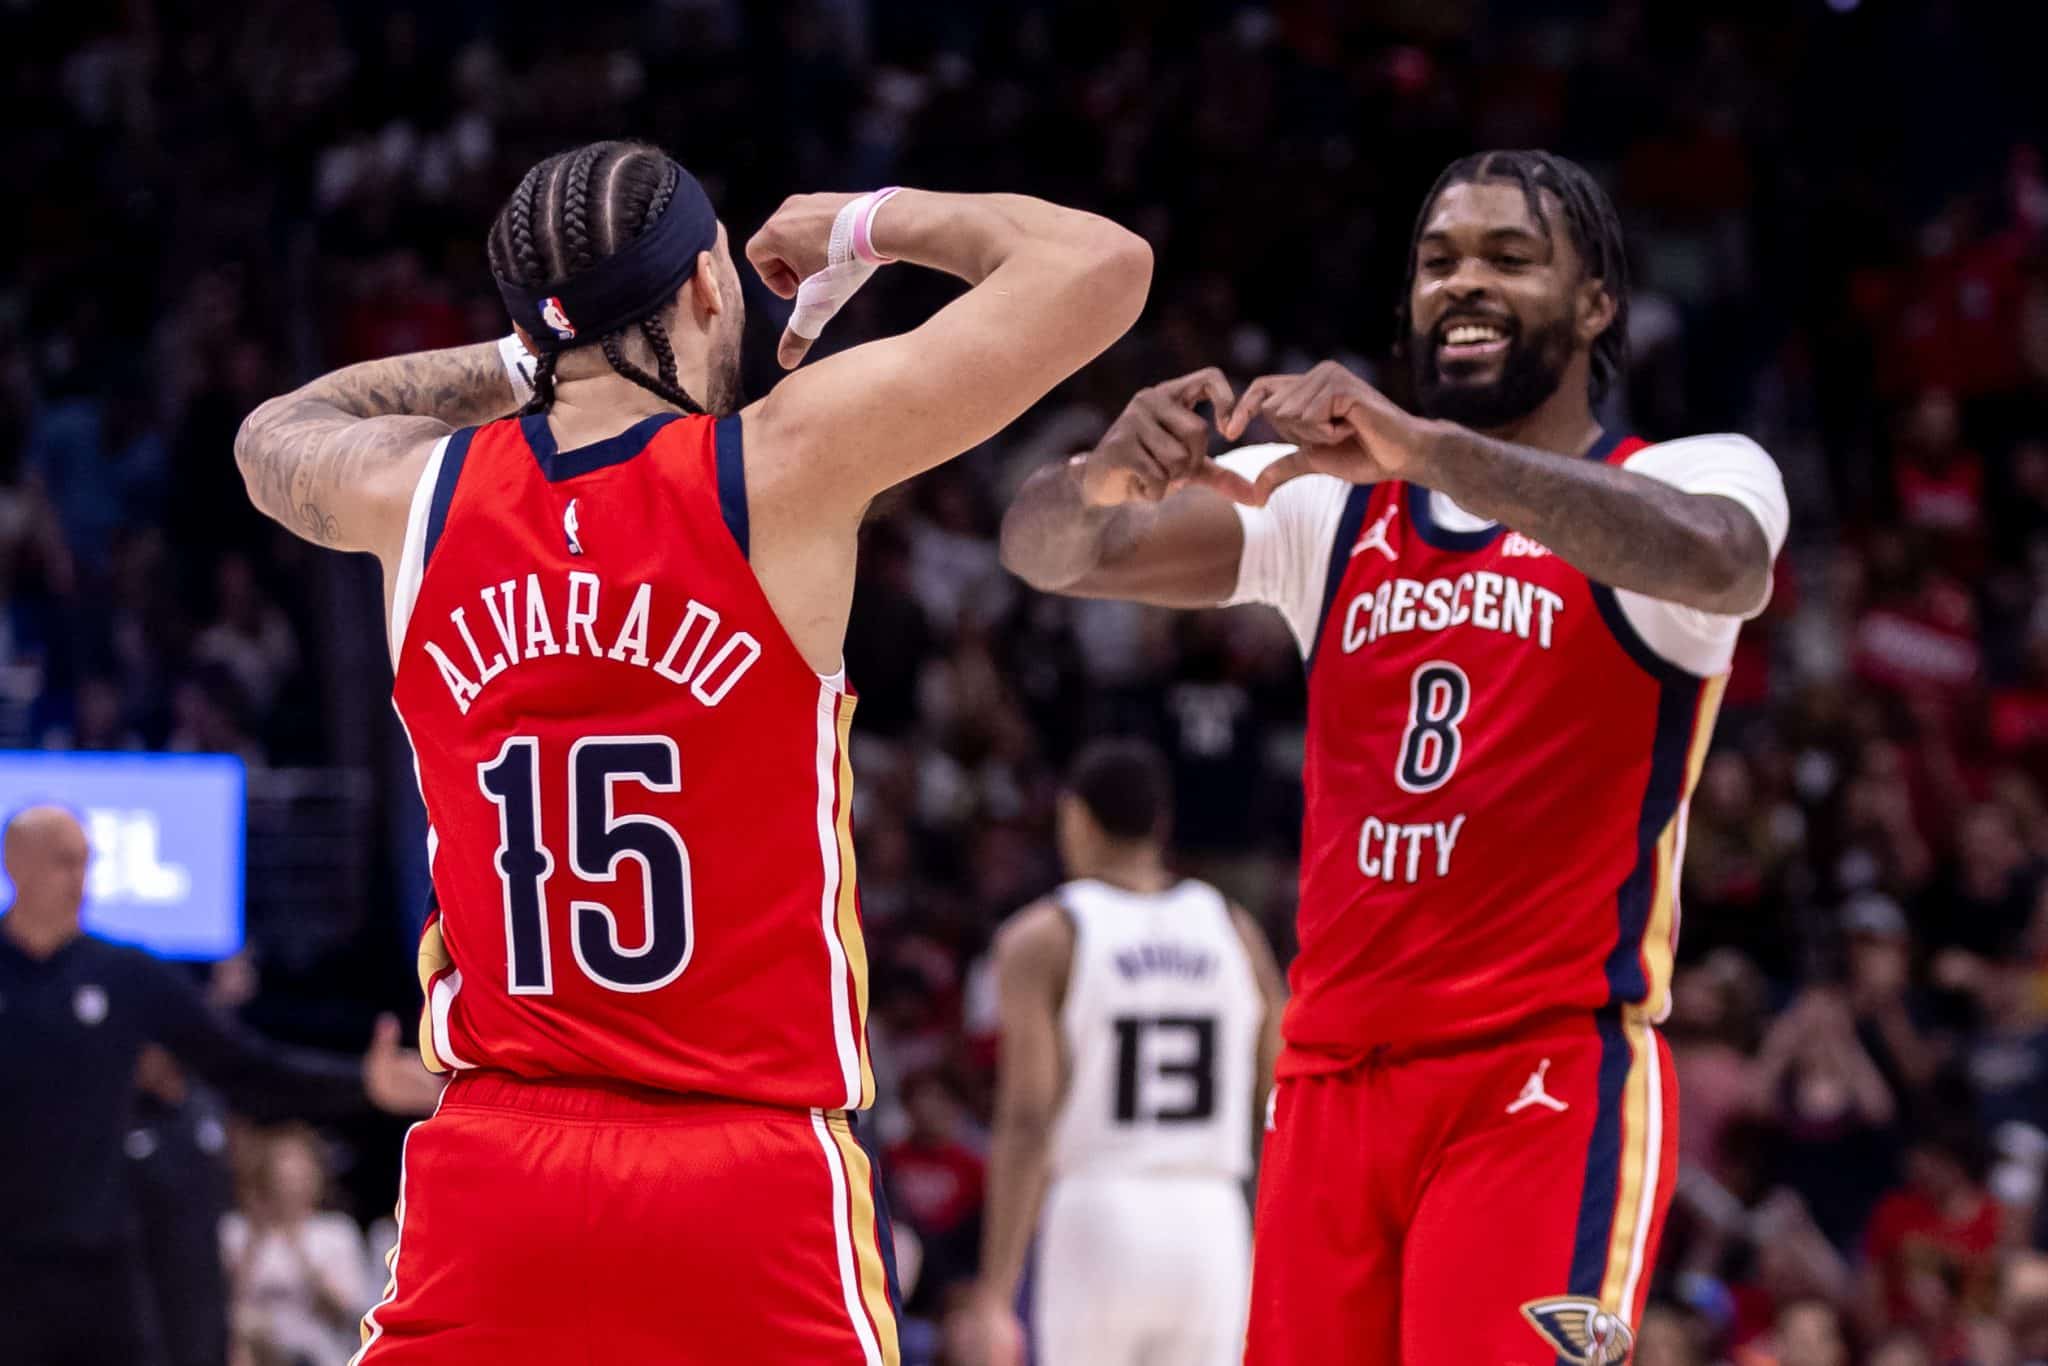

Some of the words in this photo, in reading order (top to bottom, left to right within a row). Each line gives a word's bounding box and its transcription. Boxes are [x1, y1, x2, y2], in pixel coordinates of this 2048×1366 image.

[424, 571, 761, 715] ALVARADO
[1342, 570, 1563, 654] CRESCENT
[1395, 660, 1470, 793] 8
[477, 735, 694, 996] 15
[1358, 814, 1466, 882] CITY
[1112, 1014, 1219, 1124] 13
